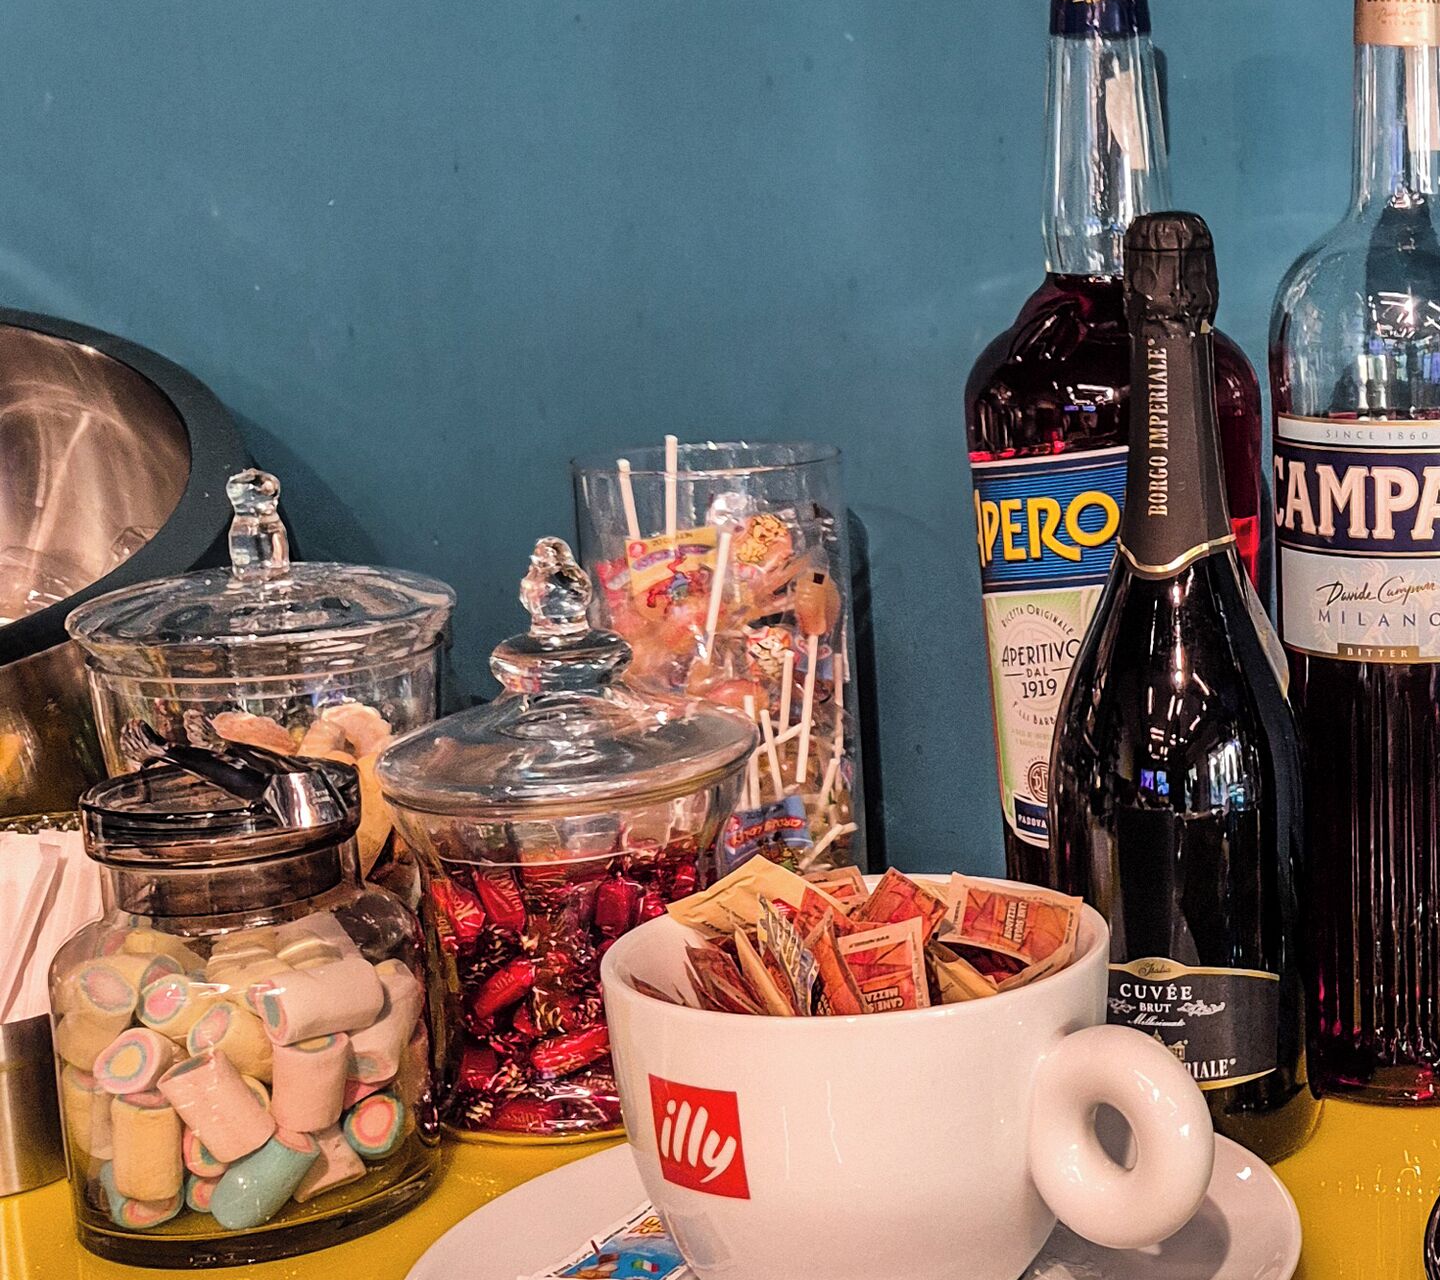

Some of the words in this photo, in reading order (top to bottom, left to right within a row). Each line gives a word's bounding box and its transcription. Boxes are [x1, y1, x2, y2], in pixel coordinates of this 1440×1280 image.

[1326, 430, 1375, 440] SINCE
[1388, 430, 1429, 441] 1860
[1147, 455, 1168, 516] BORGO
[1001, 638, 1081, 667] APERITIVO
[1347, 647, 1408, 658] BITTER
[1026, 666, 1048, 678] DAL
[1022, 678, 1057, 699] 1919
[1119, 983, 1193, 1001] CUVÉE
[1139, 1002, 1172, 1013] BRUT
[660, 1099, 737, 1183] illy
